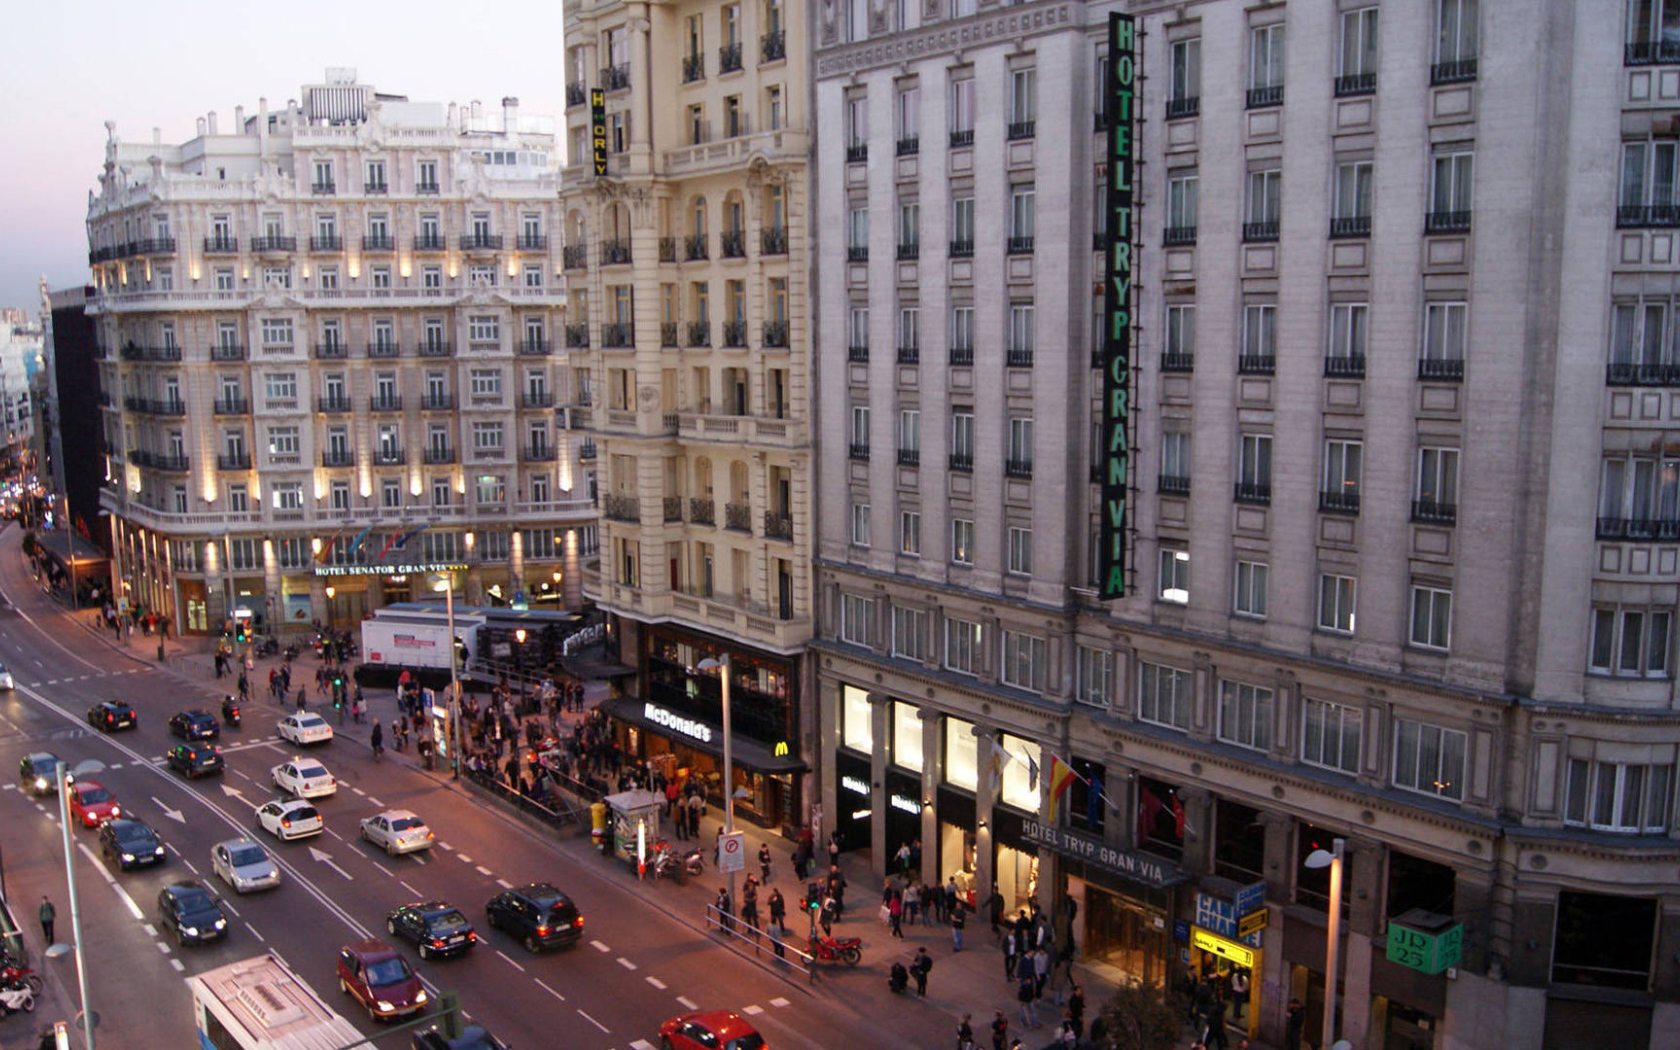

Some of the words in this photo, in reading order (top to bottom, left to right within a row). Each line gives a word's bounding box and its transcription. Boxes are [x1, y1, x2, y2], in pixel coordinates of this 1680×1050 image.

[1116, 19, 1133, 191] HOTEL
[1113, 207, 1130, 340] TRYP
[1109, 356, 1128, 486] GRAN
[315, 567, 347, 576] HOTEL
[349, 565, 395, 575] SENATOR
[399, 564, 426, 574] GRAN
[429, 564, 447, 572] VIA
[1107, 499, 1125, 594] VIA
[644, 702, 712, 743] McDonald's
[1022, 819, 1059, 845] HOTEL
[1063, 834, 1095, 857] TRYP
[1099, 847, 1135, 872] GRAN
[1140, 860, 1163, 882] VIA
